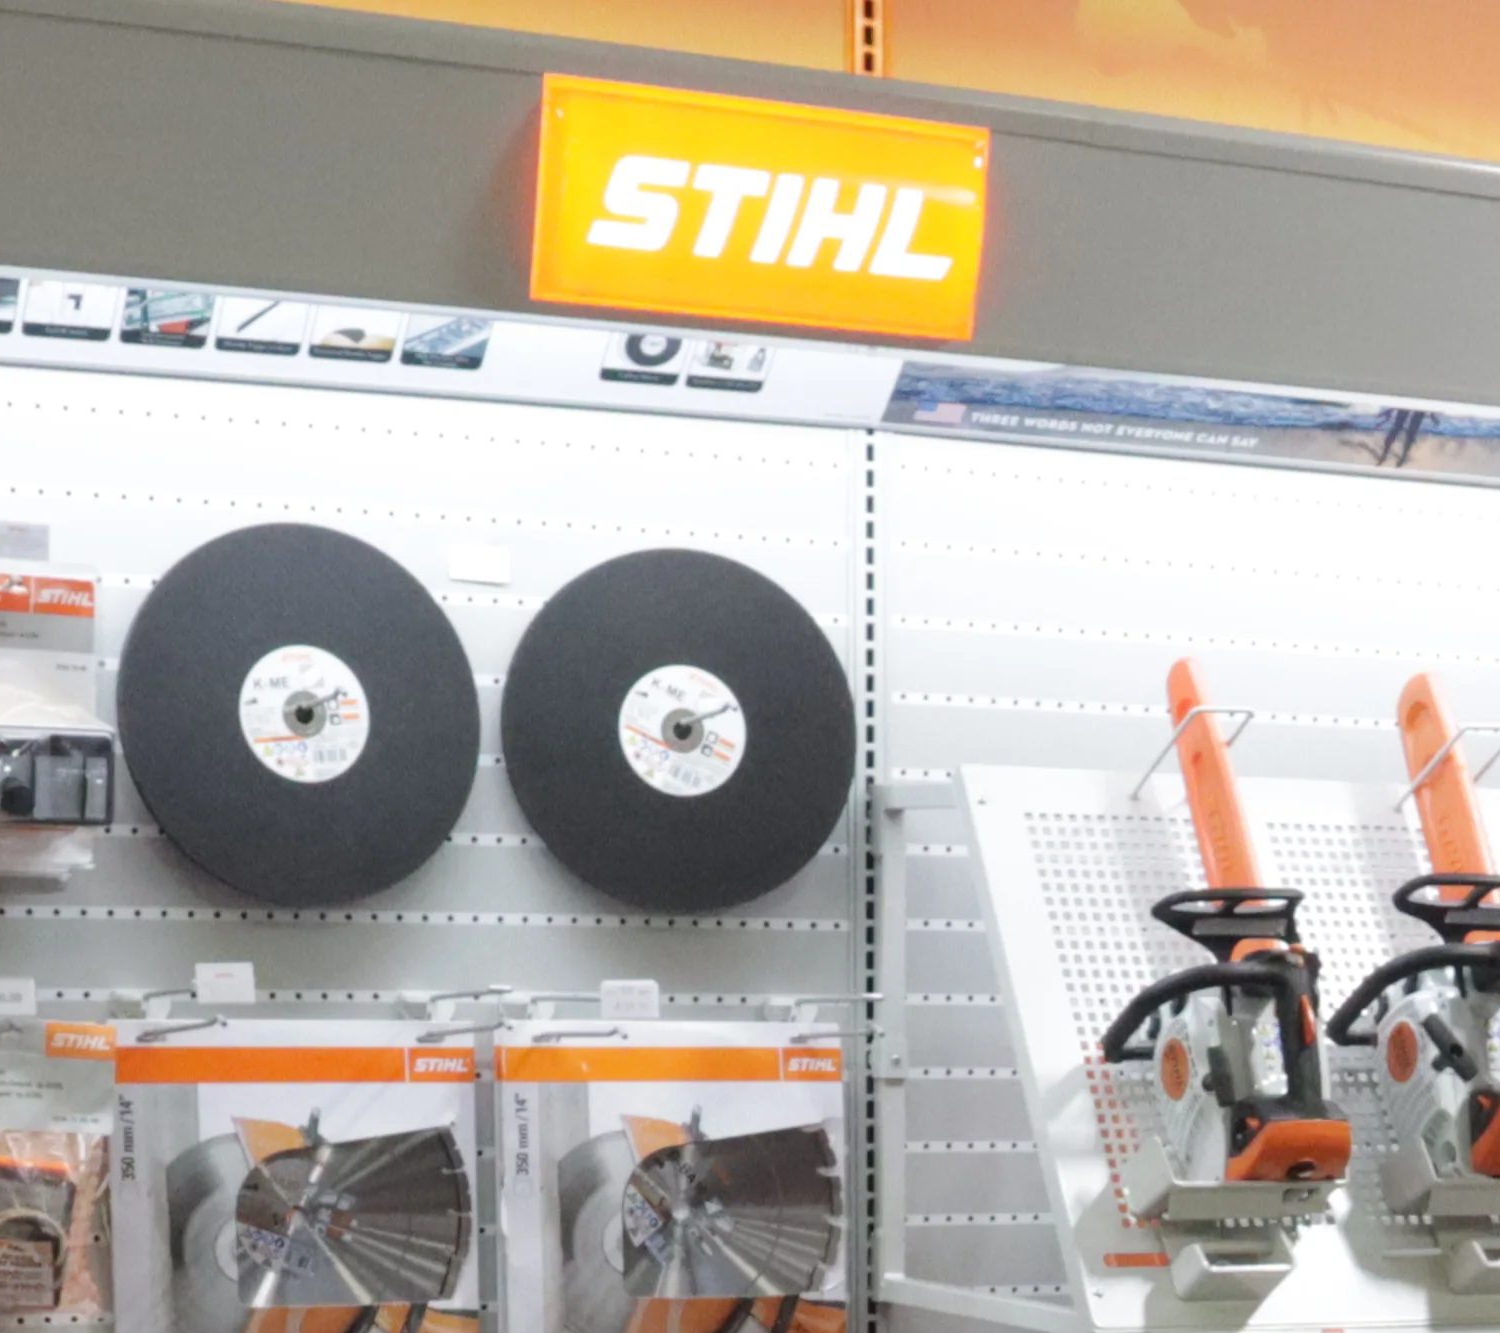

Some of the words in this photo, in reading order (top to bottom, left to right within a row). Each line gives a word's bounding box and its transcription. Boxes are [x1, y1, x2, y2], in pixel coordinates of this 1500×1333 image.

[587, 155, 953, 281] STIHL
[971, 411, 1020, 428] THREE
[1023, 416, 1077, 433] WORDS
[1079, 421, 1114, 434] NOT
[1116, 424, 1193, 442] EVERYONE
[1196, 431, 1228, 445] CAN
[1231, 434, 1260, 448] SAY
[37, 588, 94, 606] STIHL
[52, 1033, 111, 1050] STIHL
[414, 1057, 468, 1073] STIHL
[787, 1057, 837, 1073] STIHL
[120, 1156, 137, 1181] 350
[514, 1152, 530, 1177] 350
